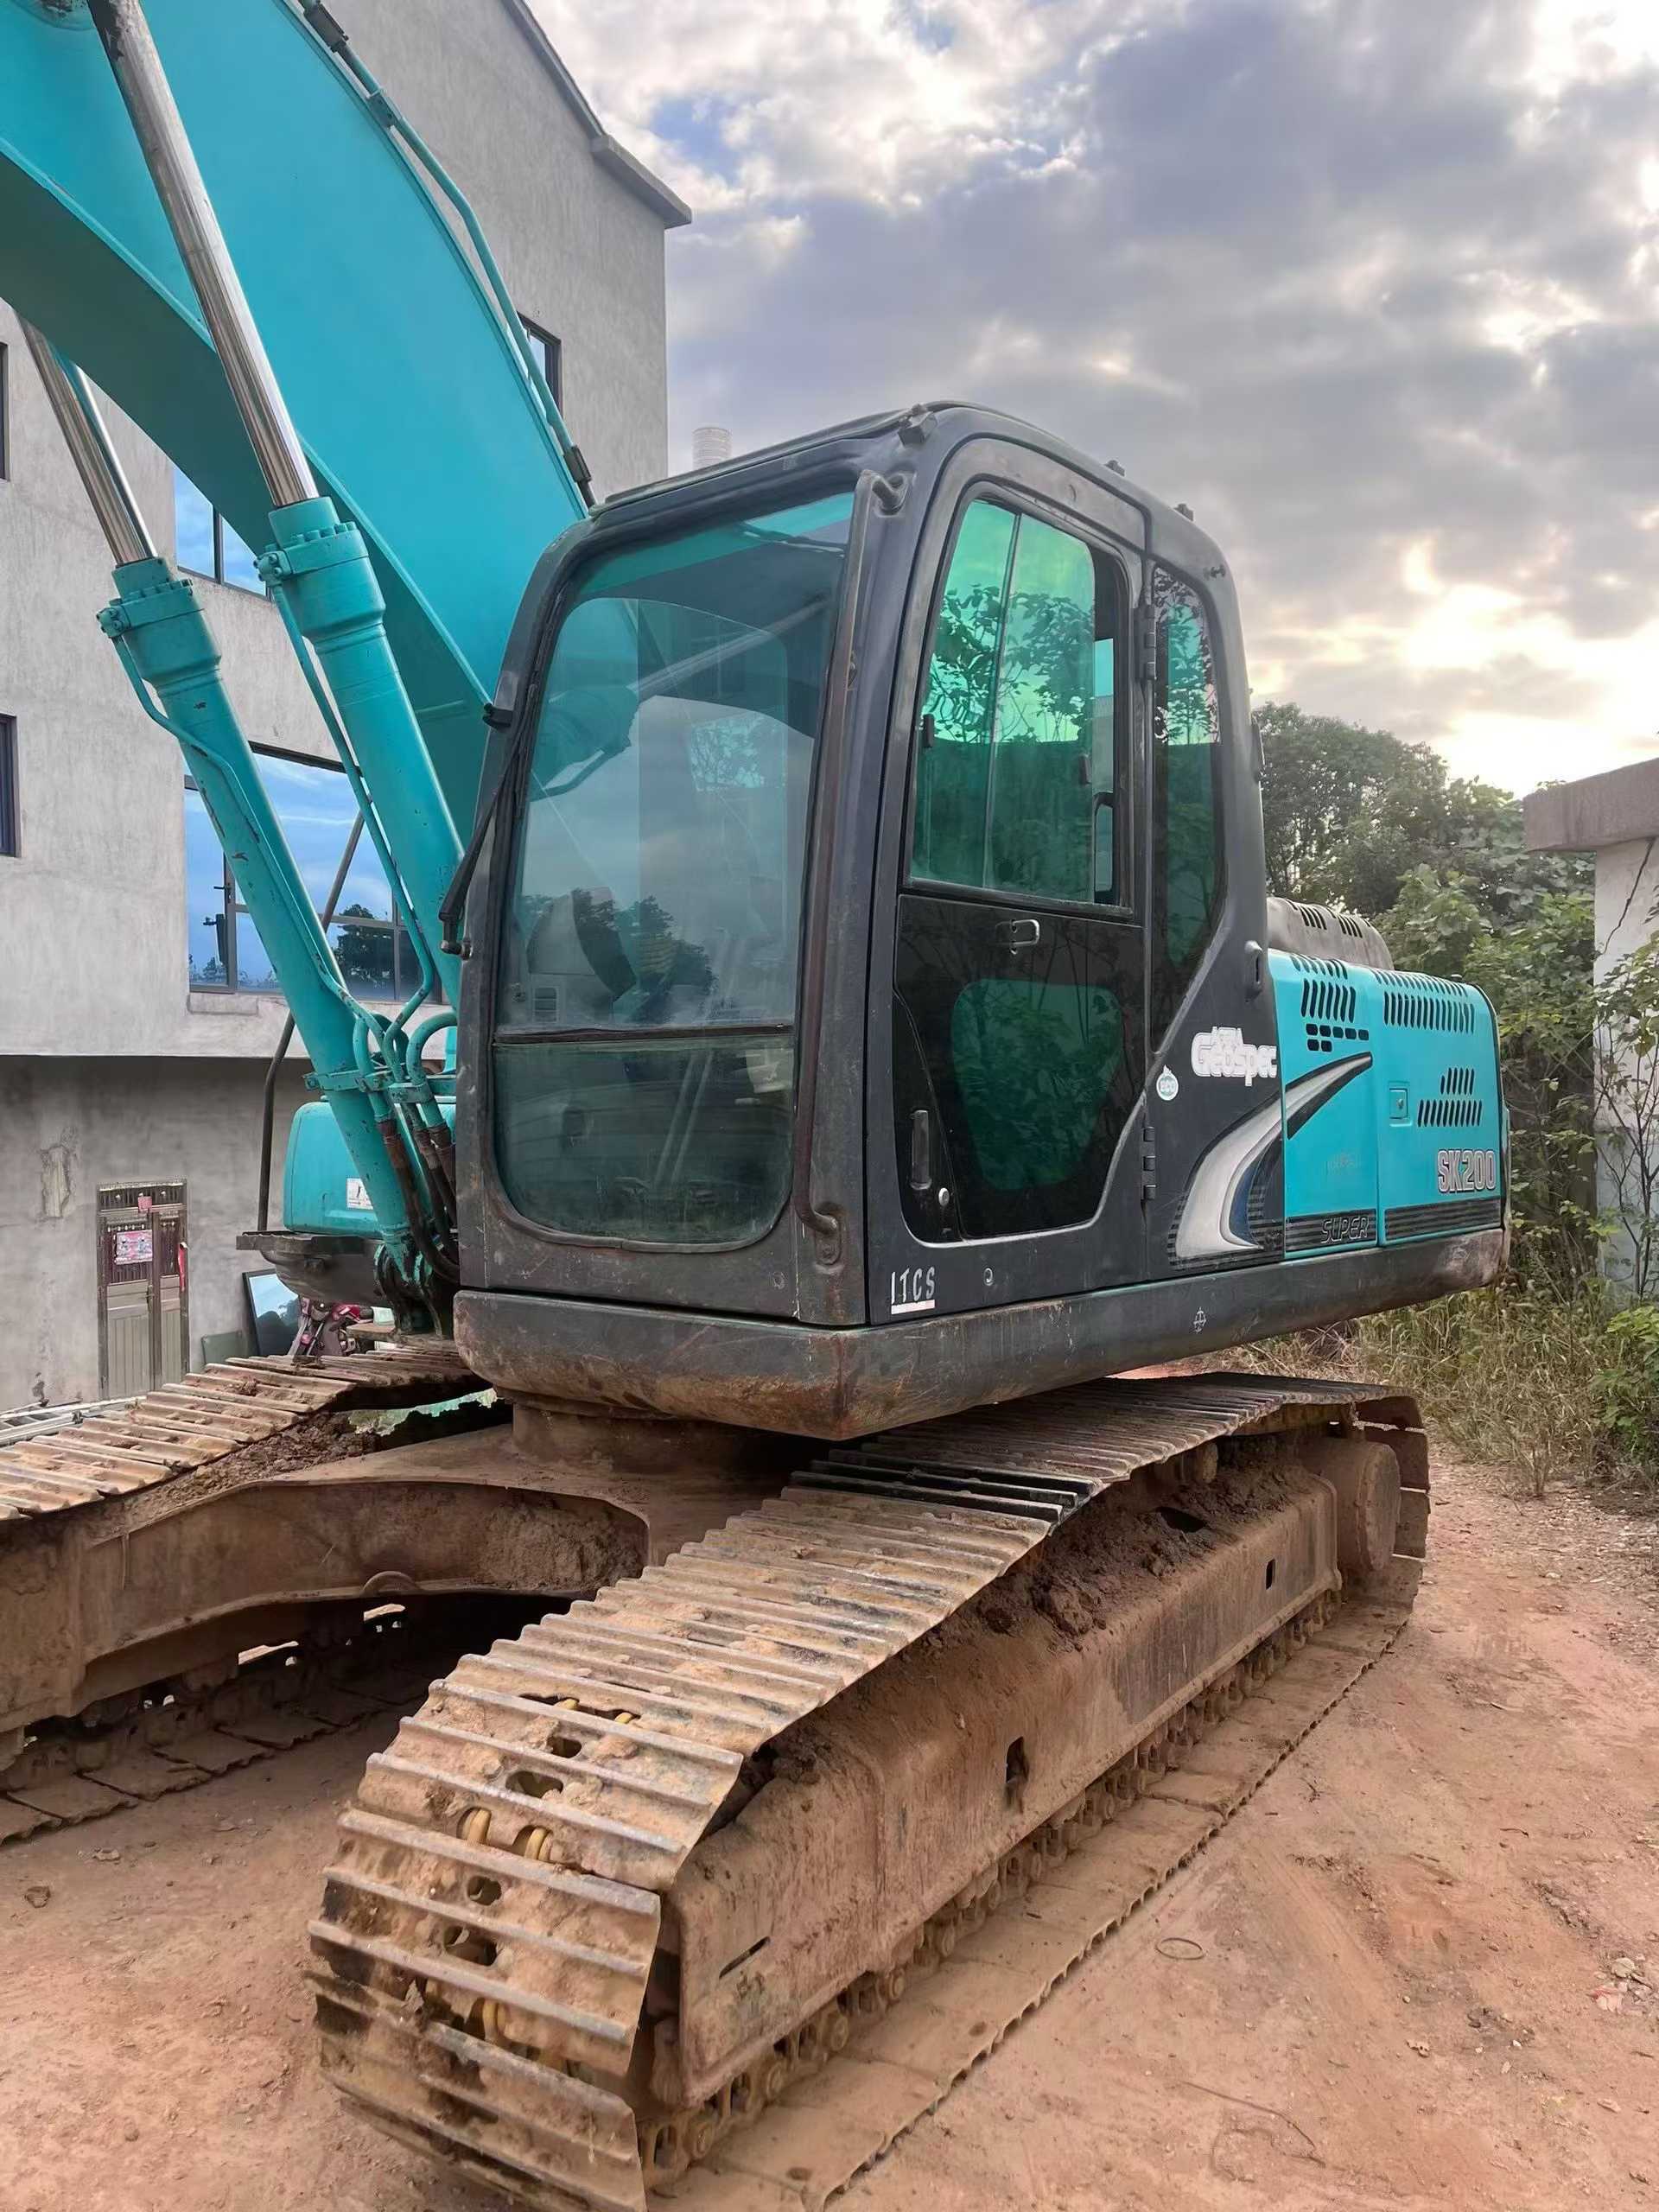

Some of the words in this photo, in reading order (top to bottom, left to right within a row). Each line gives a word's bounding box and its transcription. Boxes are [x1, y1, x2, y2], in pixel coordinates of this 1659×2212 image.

[1437, 1149, 1497, 1192] SK200
[1320, 1214, 1370, 1244] SUPER
[891, 1266, 936, 1305] ITCS
